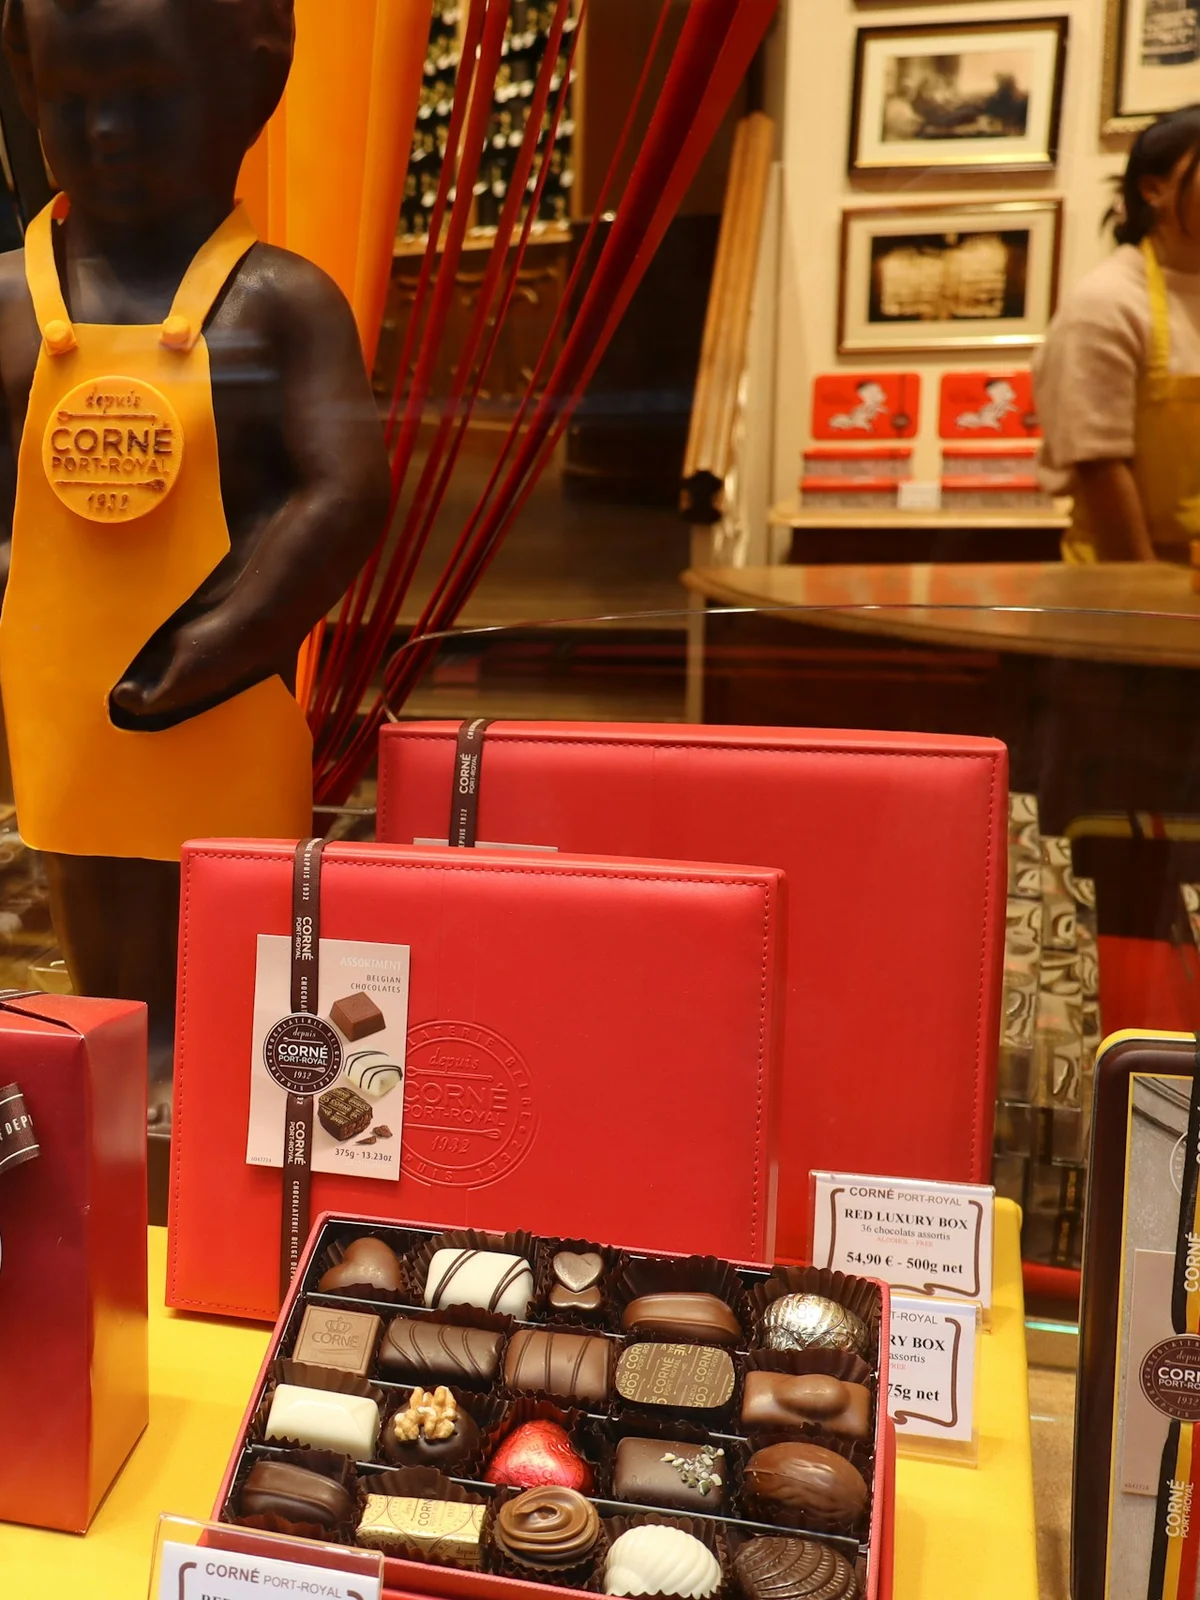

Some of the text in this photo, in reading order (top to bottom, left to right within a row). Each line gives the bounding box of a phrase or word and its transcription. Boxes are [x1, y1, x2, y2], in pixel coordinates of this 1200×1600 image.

[51, 421, 173, 455] CORNÉ
[52, 456, 170, 473] PORT-ROYAL
[459, 753, 471, 794] CORNÉ
[469, 754, 478, 794] PORT-ROYAL
[302, 916, 314, 961] CORNÉ
[340, 957, 402, 970] ASSORTMENT
[350, 983, 401, 994] CHOCOLATES
[366, 974, 401, 984] BELGIAN
[300, 976, 309, 1013] CHOCOLAT
[292, 1027, 316, 1040] depuis
[408, 1025, 496, 1048] LATERIE
[278, 1044, 328, 1059] CORNÉ
[278, 1055, 328, 1066] PORT-ROYAL
[429, 1047, 480, 1073] depuis
[293, 1070, 312, 1080] 1932
[404, 1081, 509, 1111] CORNÉ
[5, 1115, 33, 1135] DEP
[403, 1103, 506, 1126] PORT-ROYAL
[287, 1121, 295, 1164] PORT-ROYAL
[294, 1121, 306, 1166] CORNÉ
[431, 1135, 471, 1154] 1932
[335, 1148, 355, 1159] 375g
[361, 1151, 393, 1163] 13.23oz
[404, 1154, 454, 1181] PUIS
[849, 1187, 962, 1206] CORNÉ PORT-ROYAL
[844, 1208, 968, 1230] RED LUXURY BOX
[861, 1224, 951, 1241] 36 chocolats assortis
[846, 1251, 882, 1266] 54,90
[885, 1255, 894, 1267] €
[906, 1257, 938, 1274] 500g
[942, 1262, 963, 1274] net
[891, 1311, 938, 1325] T-ROYAL
[912, 1337, 945, 1351] BOX
[626, 1344, 643, 1369] COR
[889, 1353, 926, 1363] assortis
[1144, 1340, 1200, 1379] CHOCOLATER
[1176, 1350, 1200, 1365] depui
[653, 1357, 675, 1394] CORNÉ
[1158, 1367, 1200, 1383] COR
[1158, 1378, 1200, 1390] PORT-RO
[888, 1383, 940, 1401] 75g net
[418, 1499, 433, 1526] CORN
[1165, 1479, 1185, 1538] CORNÉ
[1180, 1482, 1195, 1538] PORT-ROYAL
[205, 1562, 342, 1599] CORNÉ PORT-ROYAL
